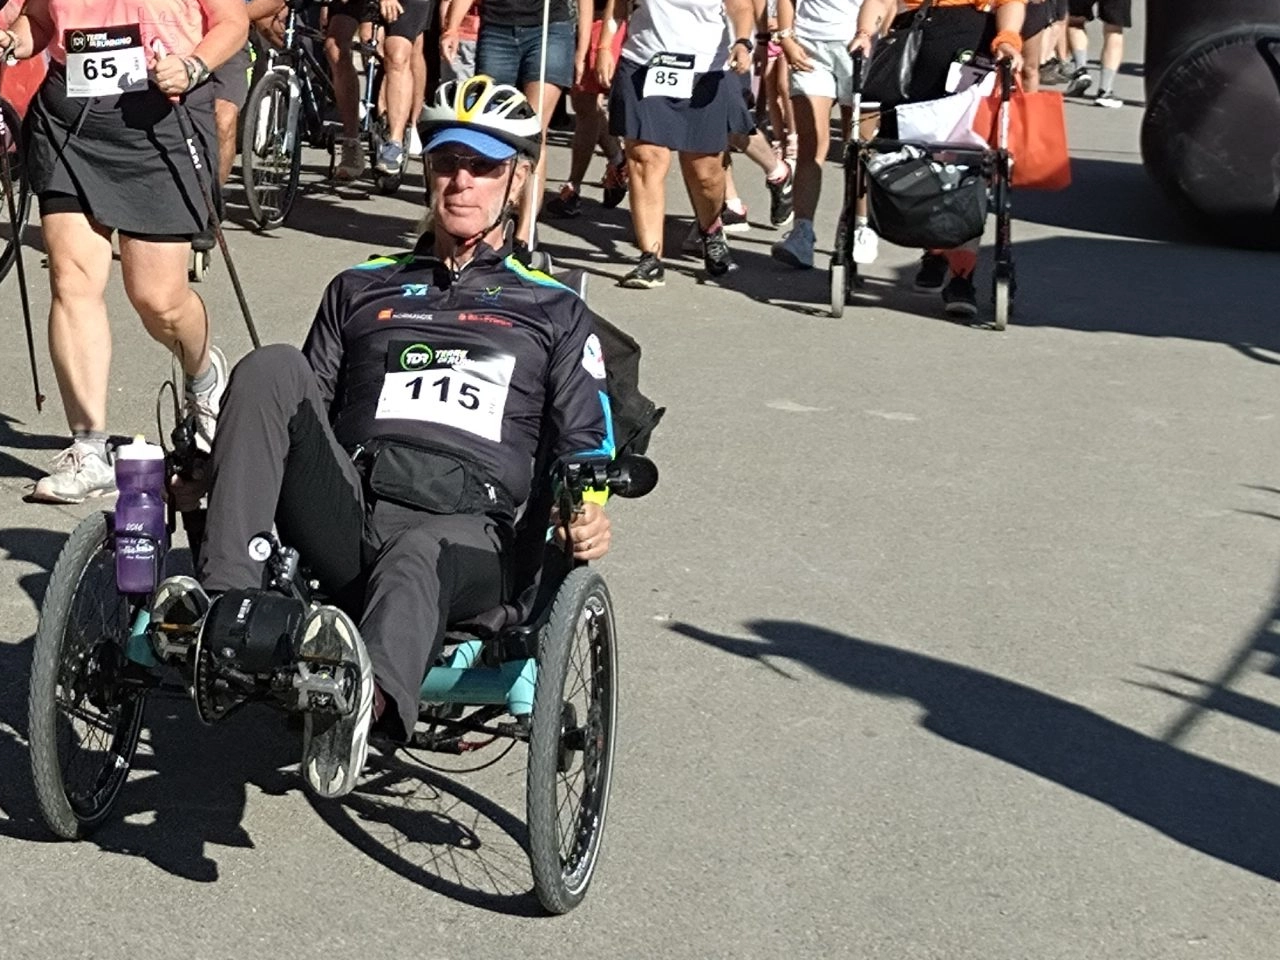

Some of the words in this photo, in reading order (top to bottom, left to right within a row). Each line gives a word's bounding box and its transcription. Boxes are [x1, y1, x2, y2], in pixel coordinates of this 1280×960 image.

[83, 57, 118, 80] 65
[655, 70, 679, 86] 85
[404, 375, 481, 411] 115
